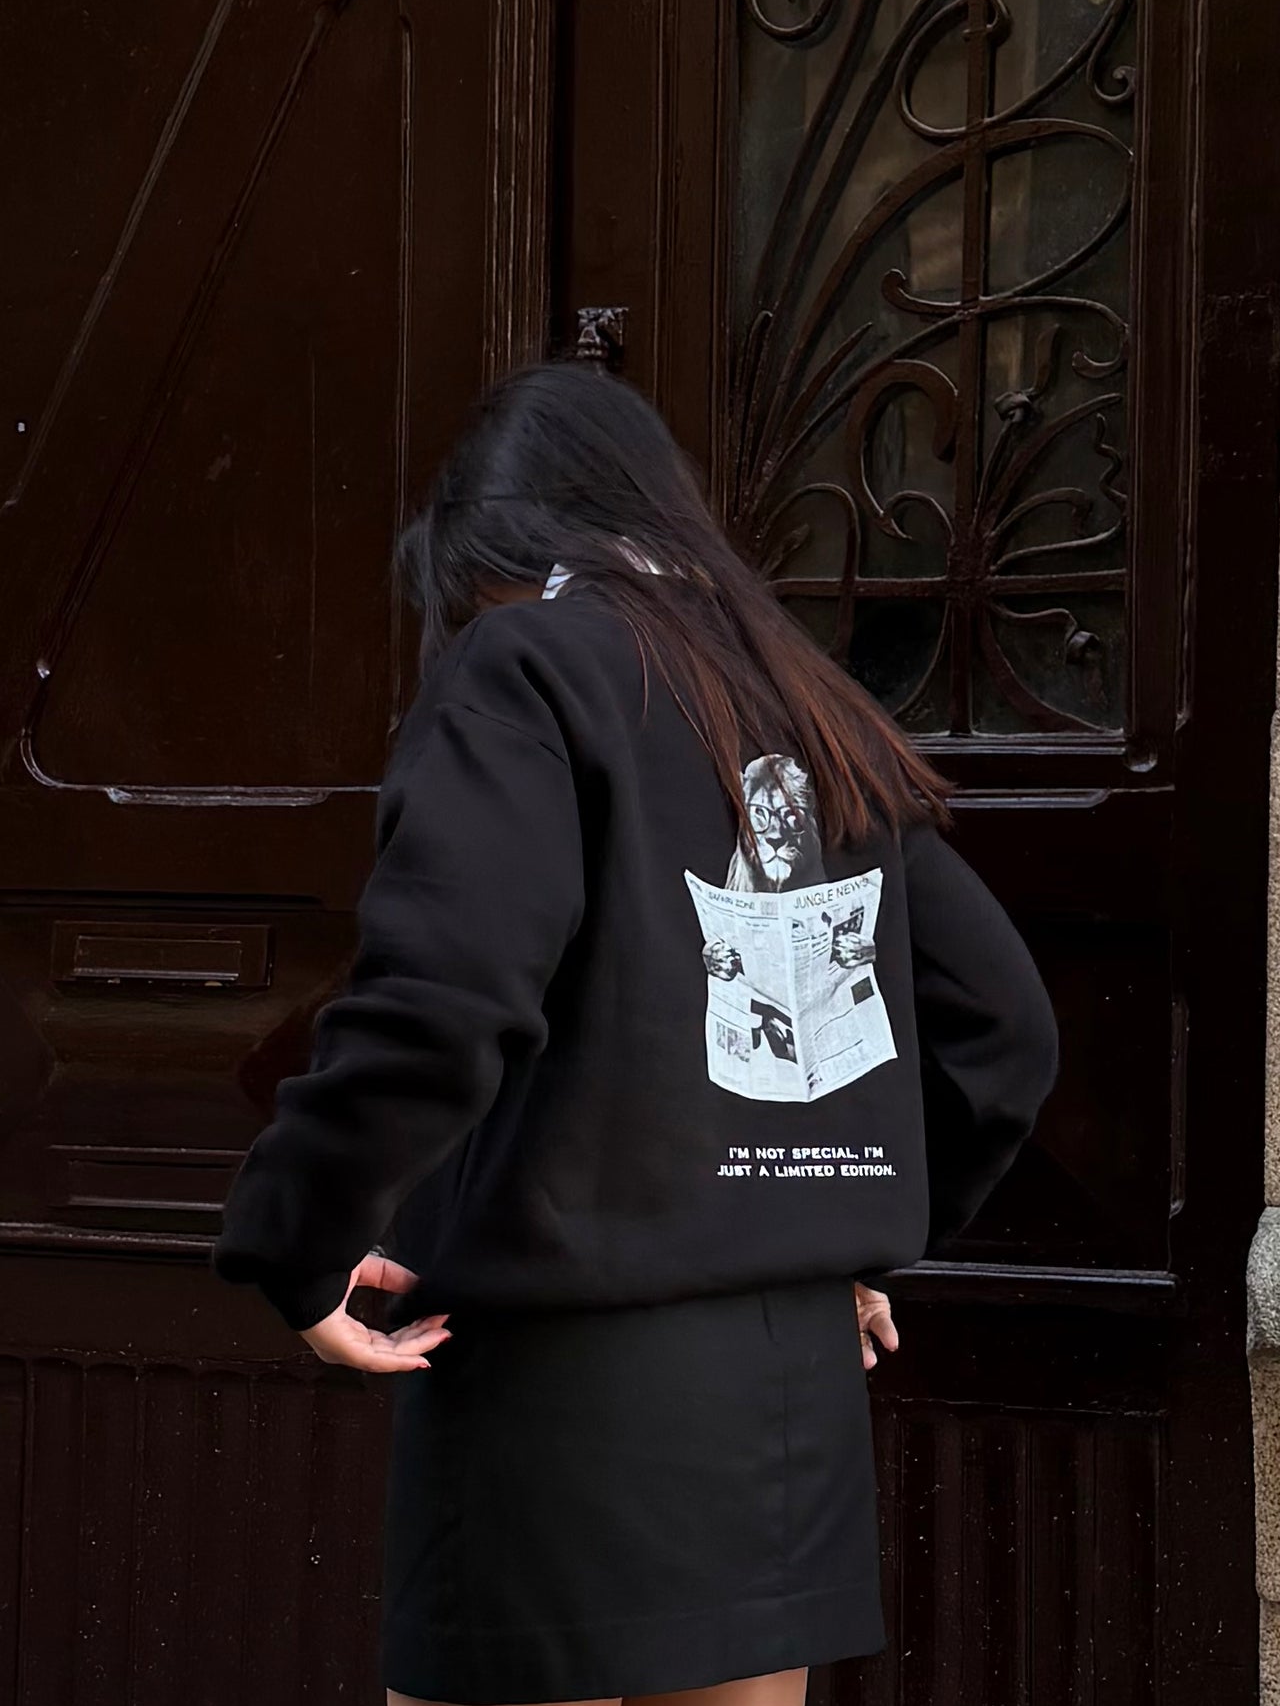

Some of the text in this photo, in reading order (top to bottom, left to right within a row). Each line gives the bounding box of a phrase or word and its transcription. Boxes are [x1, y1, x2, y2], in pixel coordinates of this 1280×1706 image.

[793, 877, 870, 909] JUNGLE NEWS
[728, 1146, 884, 1161] I'M NOT SPECIAL, I'M
[717, 1164, 897, 1177] JUST A LIMITED EDITION.
